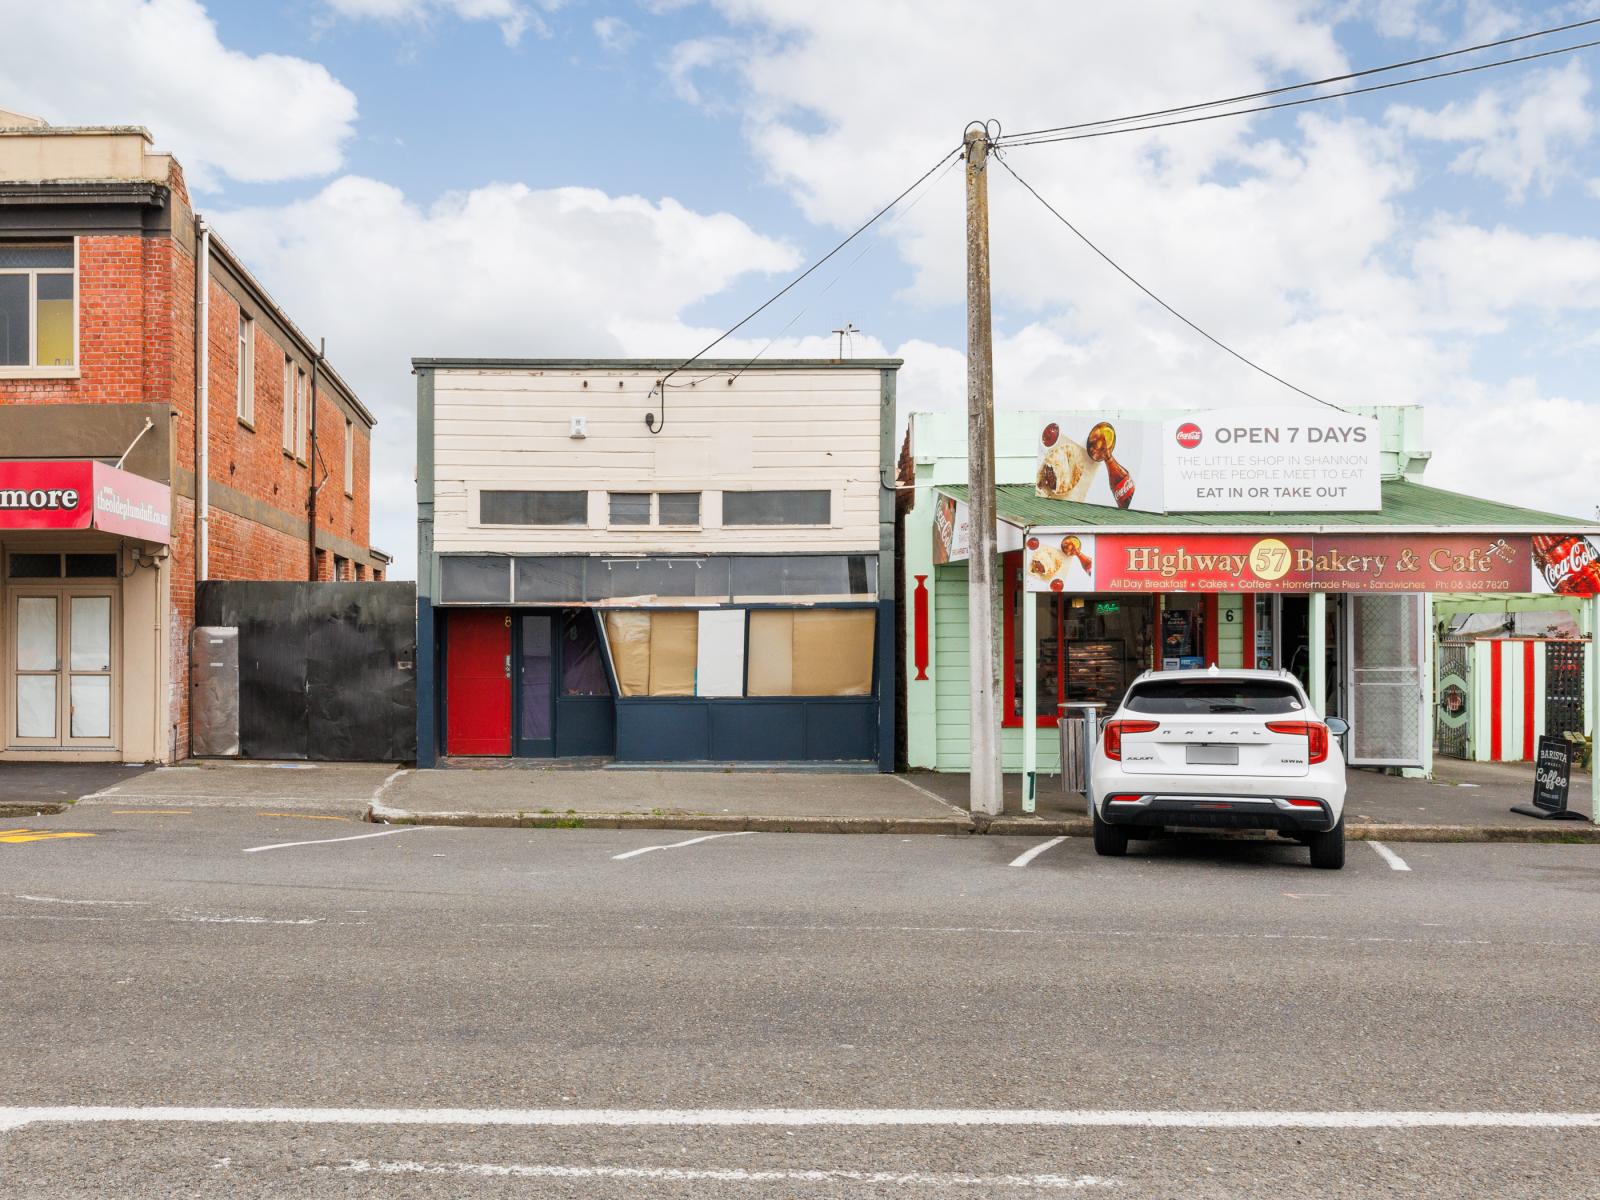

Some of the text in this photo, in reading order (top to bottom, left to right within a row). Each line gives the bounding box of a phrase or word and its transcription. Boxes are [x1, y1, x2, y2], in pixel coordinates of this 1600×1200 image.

[1215, 426, 1367, 444] OPEN 7 DAYS
[1176, 455, 1368, 466] THE LITTLE SHOP IN SHANNON
[1180, 468, 1365, 480] WHERE PEOPLE MEET TO EAT
[1196, 486, 1348, 498] EAT IN OR TAKE OUT
[0, 490, 78, 508] more
[1126, 547, 1249, 577] Highway
[1255, 548, 1288, 573] 57
[1295, 548, 1389, 577] Bakery
[1395, 548, 1421, 573] &
[1110, 580, 1509, 591] All Day Breakfast Cakes Coffee Homemade Pies Sandwiches Ph: 06 362 7820
[504, 615, 512, 628] 8
[1225, 609, 1234, 622] 6
[1540, 749, 1567, 763] BARISTA
[1536, 767, 1568, 790] Coffee
